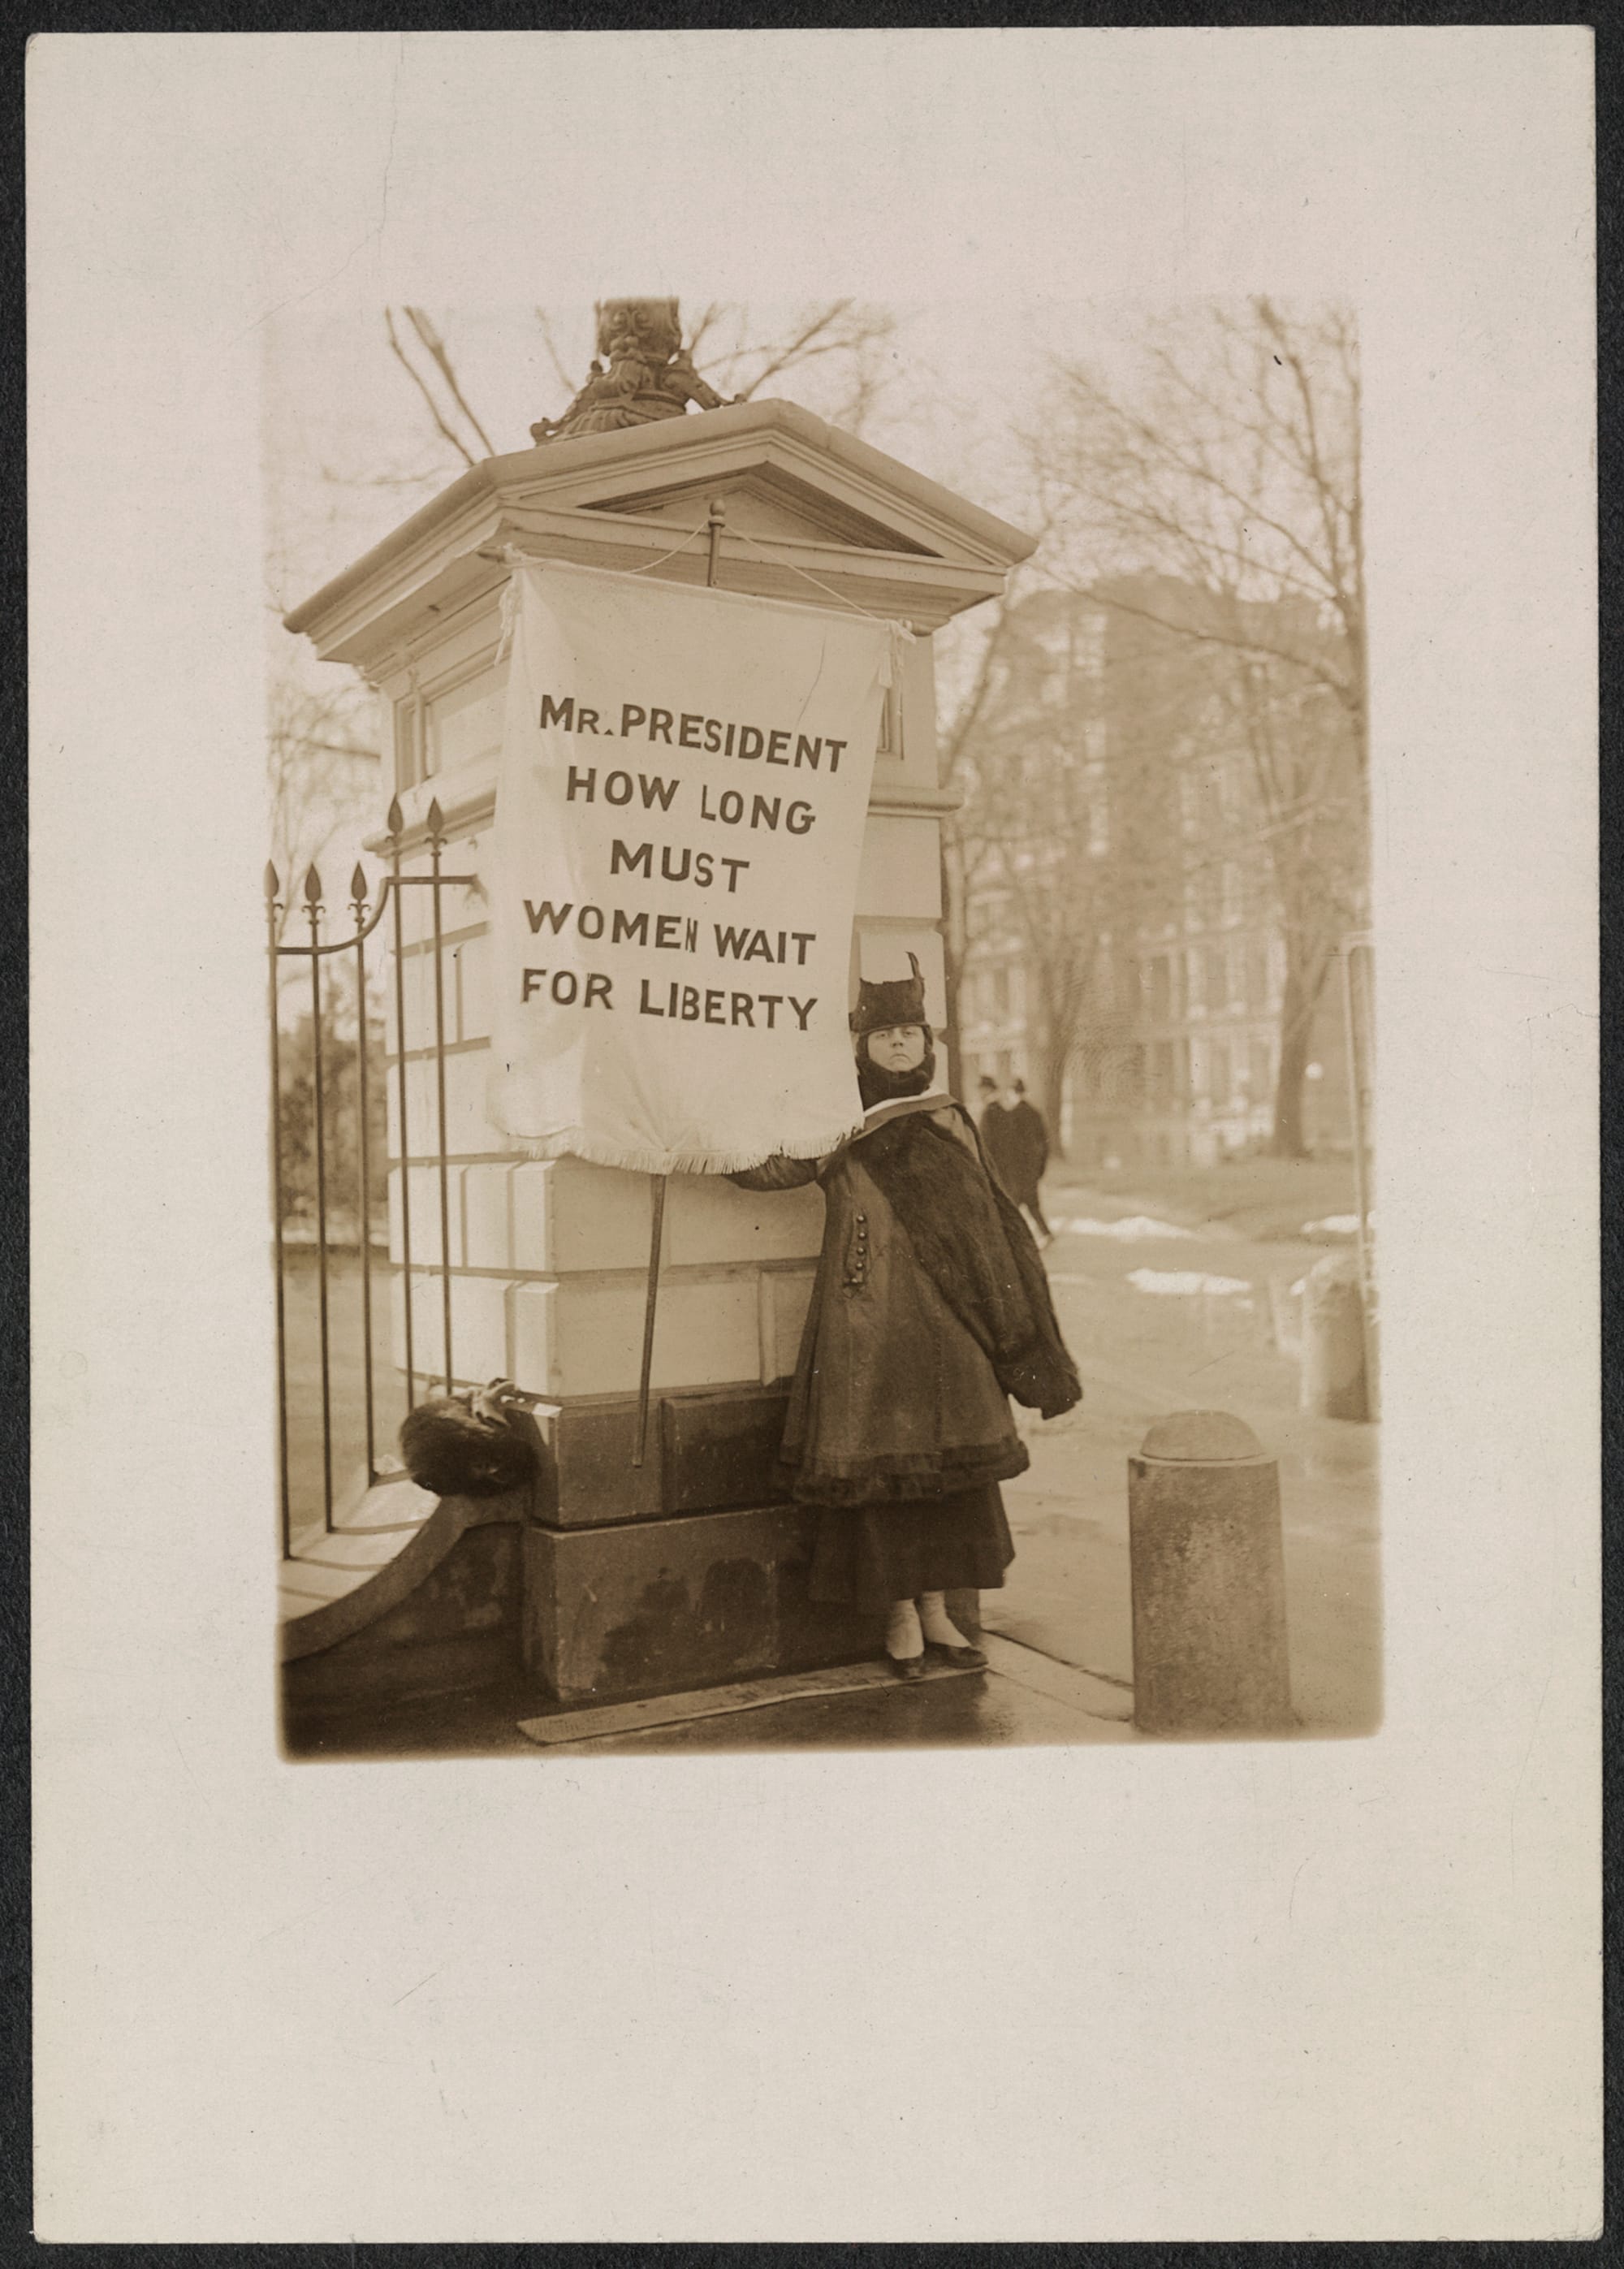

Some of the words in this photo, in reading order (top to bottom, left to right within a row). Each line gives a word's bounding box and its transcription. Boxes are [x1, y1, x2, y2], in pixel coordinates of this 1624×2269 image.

[620, 702, 848, 773] PRESIDENT
[566, 765, 680, 812] HOW
[700, 784, 816, 835] LONG
[609, 839, 750, 893] MUST
[522, 899, 698, 953] WOMEN
[713, 923, 817, 966] WAIT
[520, 967, 614, 1010] FOR
[638, 978, 818, 1031] LIBERTY
